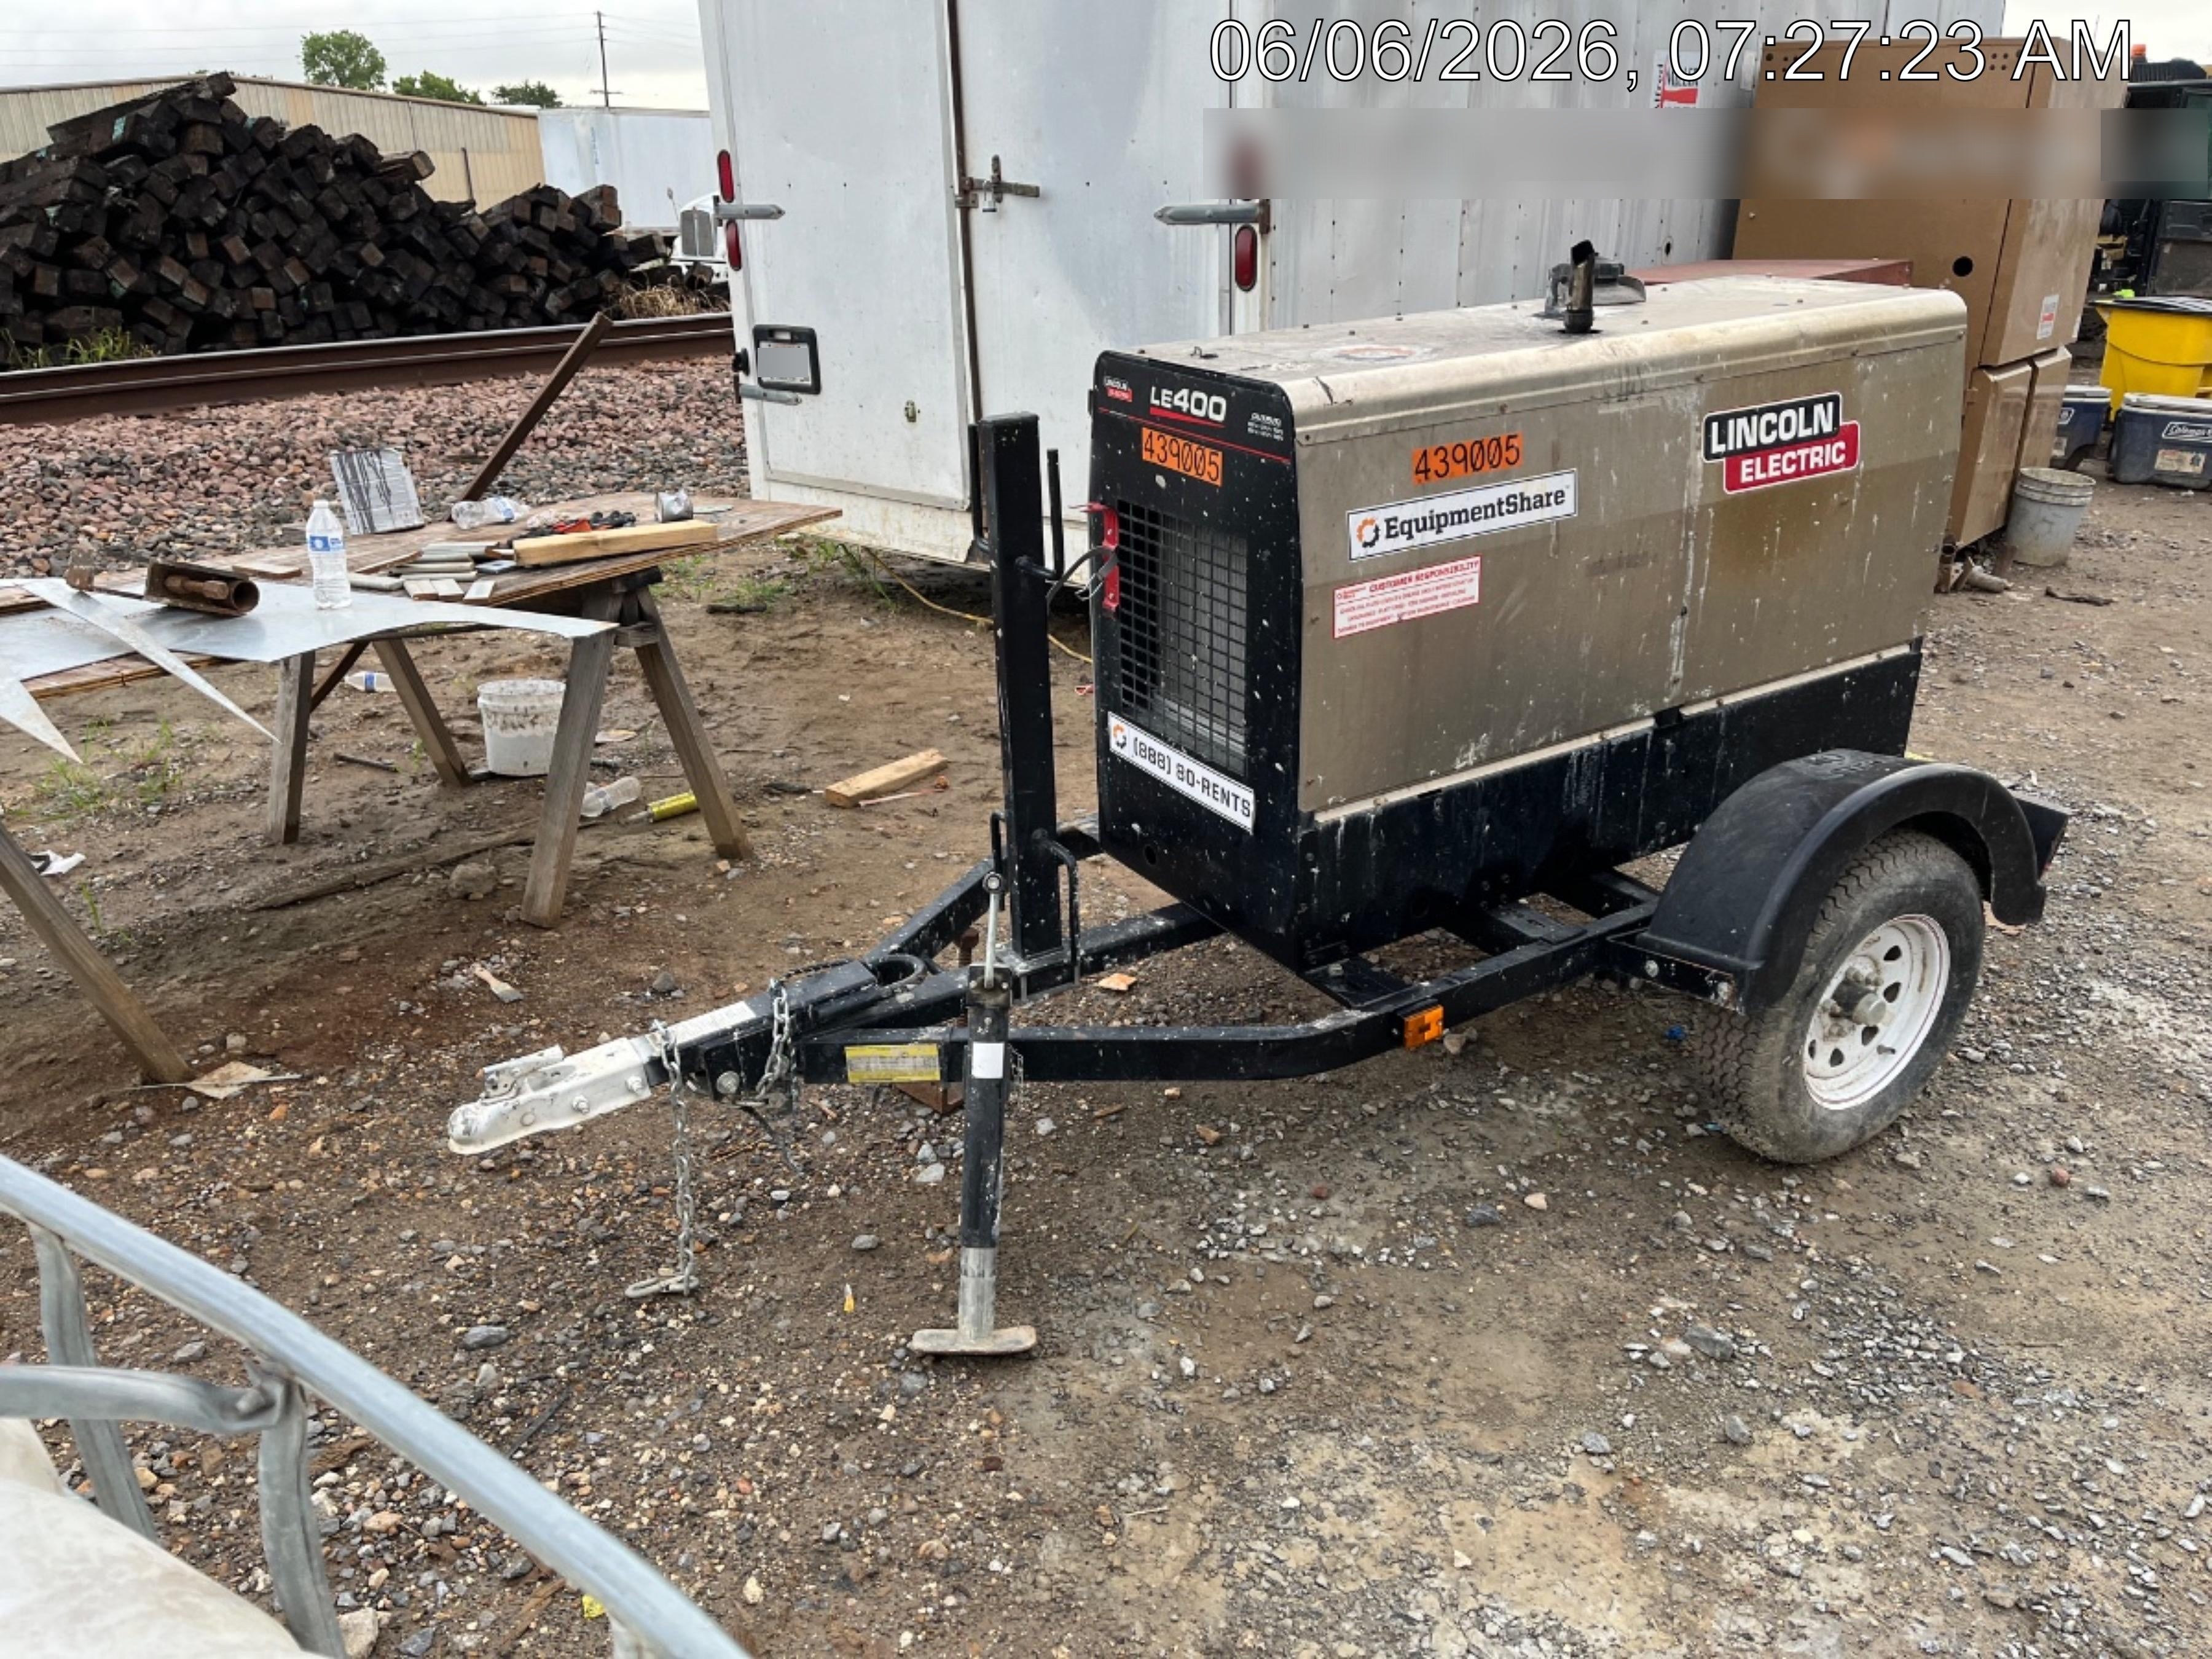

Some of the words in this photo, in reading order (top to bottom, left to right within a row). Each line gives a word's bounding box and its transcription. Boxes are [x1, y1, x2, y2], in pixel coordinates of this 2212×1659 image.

[1150, 387, 1227, 423] LE400
[1711, 401, 1834, 454] LINCOLN
[1144, 431, 1220, 482] 439005
[1415, 434, 1520, 480] 439005
[1740, 441, 1846, 484] ELECTRIC
[1385, 490, 1566, 540] EquipmentShare
[1132, 737, 1171, 774] (888)
[1176, 763, 1251, 817] 80-RENTS
